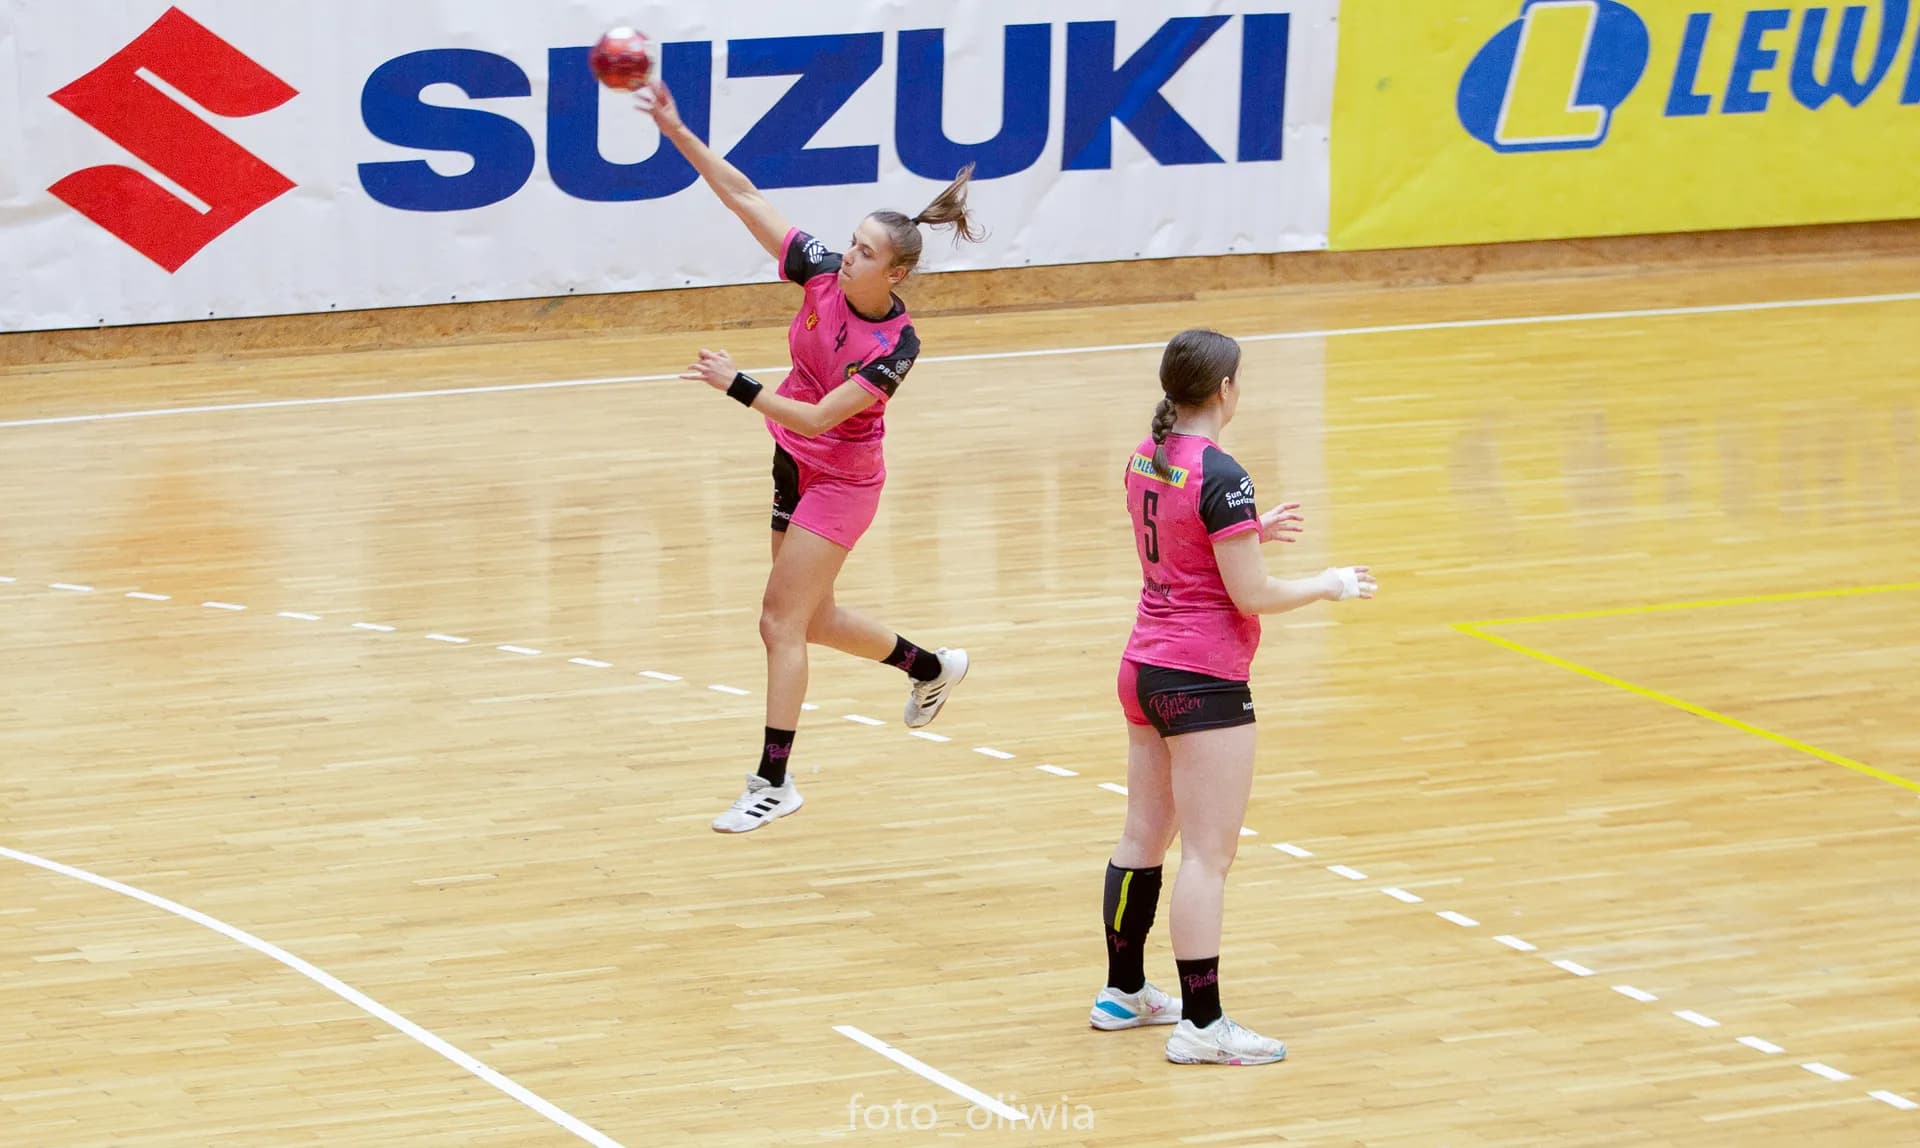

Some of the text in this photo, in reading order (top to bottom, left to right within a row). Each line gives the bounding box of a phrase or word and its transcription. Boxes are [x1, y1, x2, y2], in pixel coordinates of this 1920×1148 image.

[357, 12, 1290, 212] SUZUKI
[1143, 489, 1160, 564] 5
[1225, 491, 1242, 501] Sun
